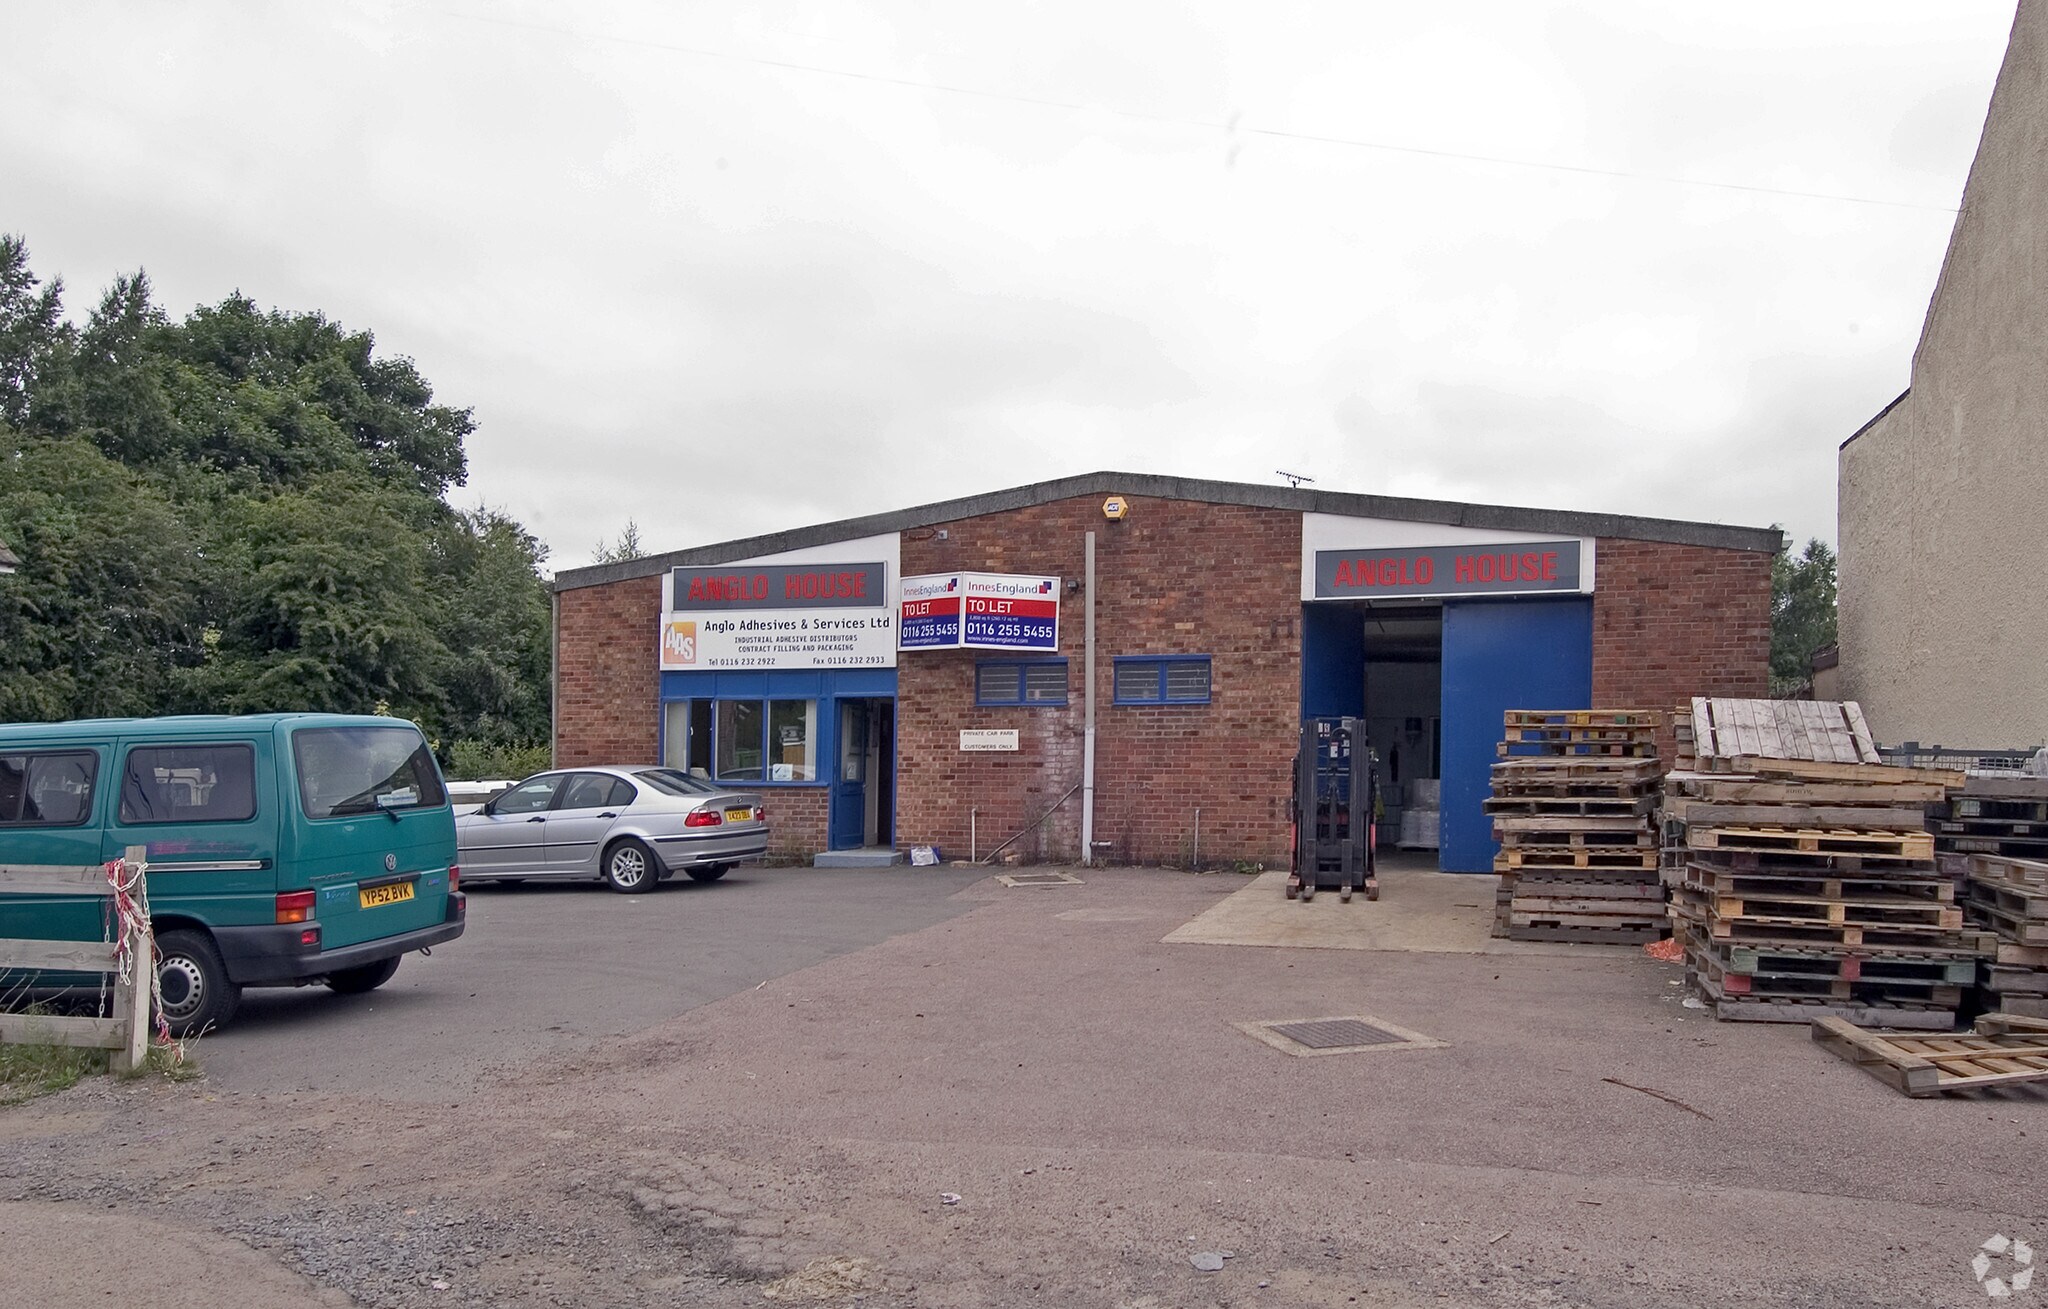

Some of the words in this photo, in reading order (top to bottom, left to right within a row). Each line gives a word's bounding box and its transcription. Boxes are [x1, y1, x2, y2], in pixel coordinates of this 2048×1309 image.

[1334, 557, 1433, 587] ANGLO
[1455, 552, 1558, 583] HOUSE
[688, 575, 769, 601] ANGLO
[785, 572, 867, 599] HOUSE
[903, 583, 947, 597] InnesEngland
[968, 580, 1038, 596] InnesEngland
[904, 604, 916, 616] TO
[917, 602, 931, 615] LET
[968, 599, 986, 613] TO
[989, 600, 1014, 614] LET
[704, 620, 735, 634] Anglo
[739, 619, 797, 631] Adhesives
[800, 618, 809, 630] &
[813, 618, 866, 630] Services
[870, 617, 890, 628] Ltd
[902, 626, 920, 638] 0116
[920, 624, 935, 637] 255
[936, 623, 958, 636] 5455
[967, 622, 995, 635] 0116
[997, 624, 1021, 637] 255
[1023, 625, 1053, 638] 5455
[734, 636, 774, 644] INDUSTRIAL
[775, 635, 808, 643] ADHESIVE
[809, 634, 858, 643] DISTRIBUTORS
[738, 645, 771, 653] CONTRACT
[773, 644, 801, 652] FILLING
[802, 643, 815, 652] AND
[817, 643, 855, 652] PACKAGING
[708, 658, 719, 666] Tel
[720, 658, 739, 666] 0116
[741, 657, 756, 665] 232
[757, 657, 776, 665] 2922
[812, 656, 825, 665] Fax
[827, 656, 847, 665] 0116
[849, 655, 864, 664] 232
[865, 655, 885, 664] 2933
[363, 886, 390, 905] YP52
[391, 883, 411, 901] BVK
